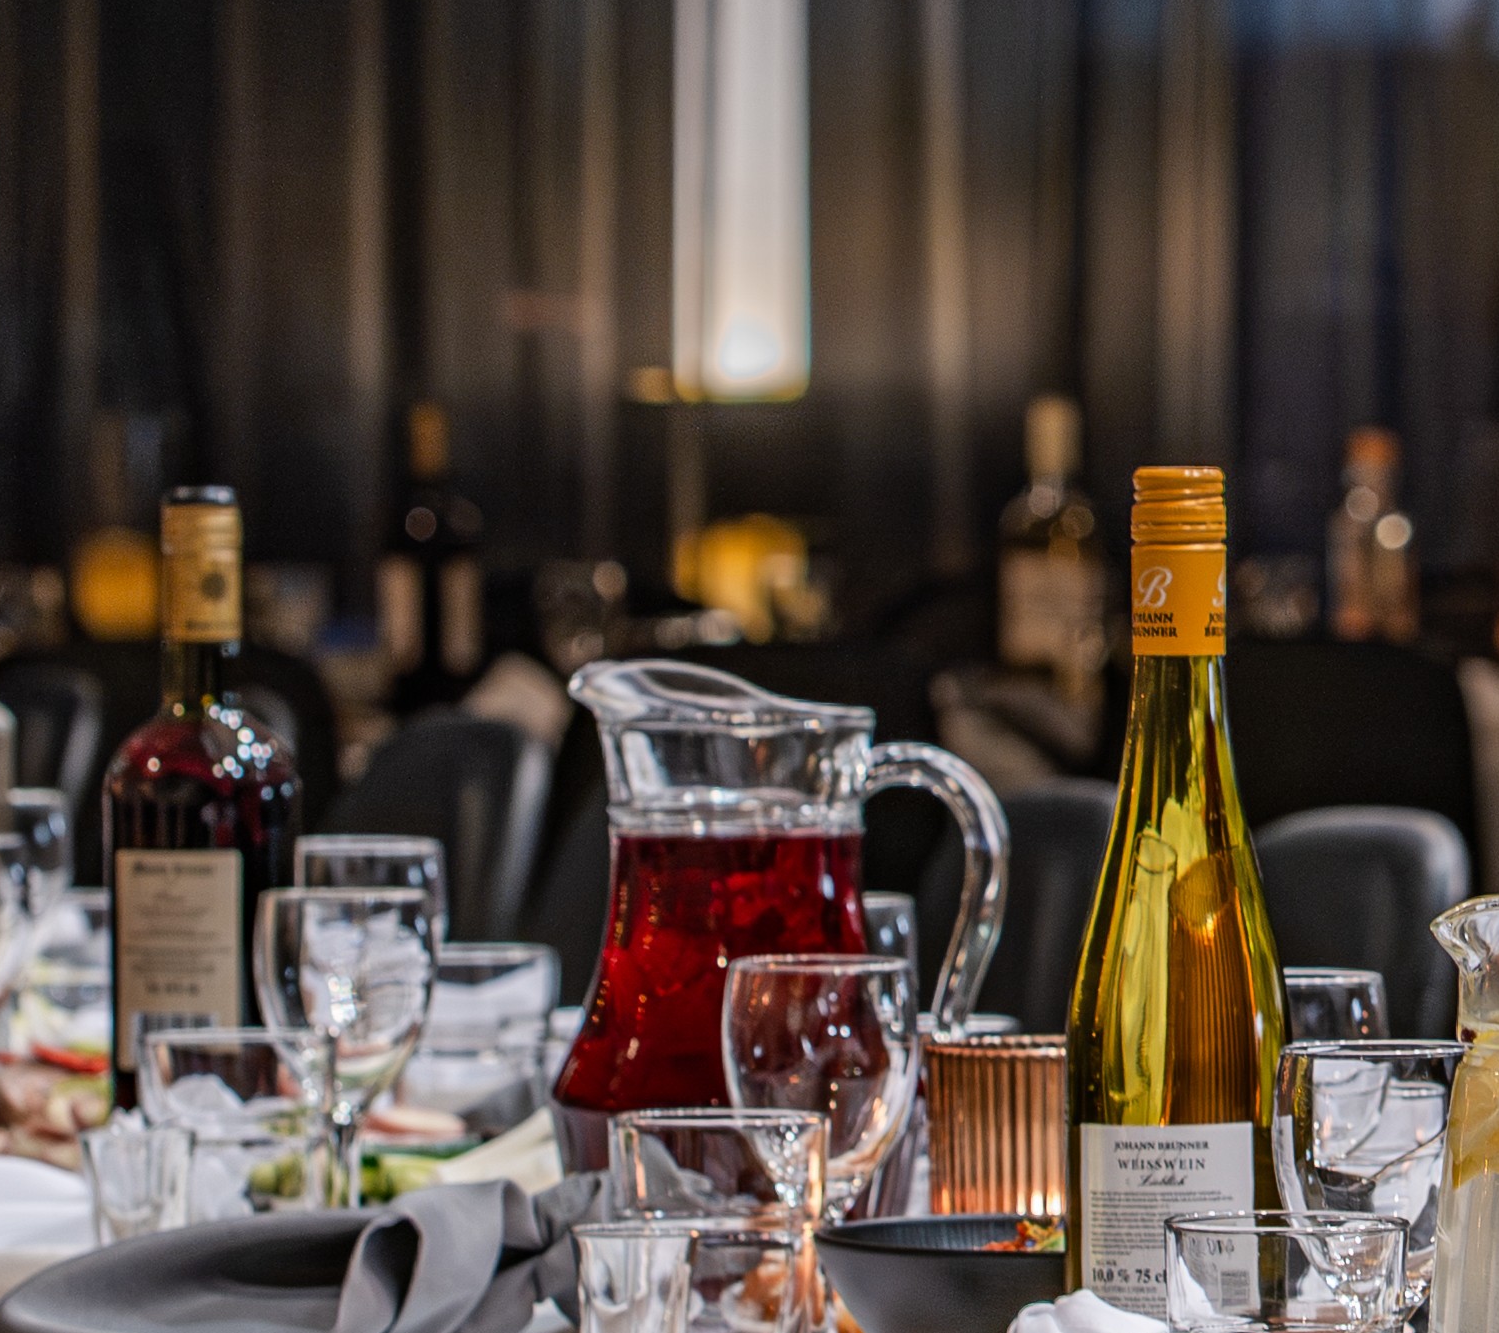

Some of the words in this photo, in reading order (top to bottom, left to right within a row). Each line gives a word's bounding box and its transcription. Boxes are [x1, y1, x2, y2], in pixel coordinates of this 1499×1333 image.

[1114, 1140, 1155, 1152] JOHANN
[1157, 1140, 1209, 1151] BRUNNER
[1117, 1158, 1206, 1170] WEISSWEIN
[1091, 1268, 1114, 1284] 10,0
[1135, 1269, 1151, 1284] 75
